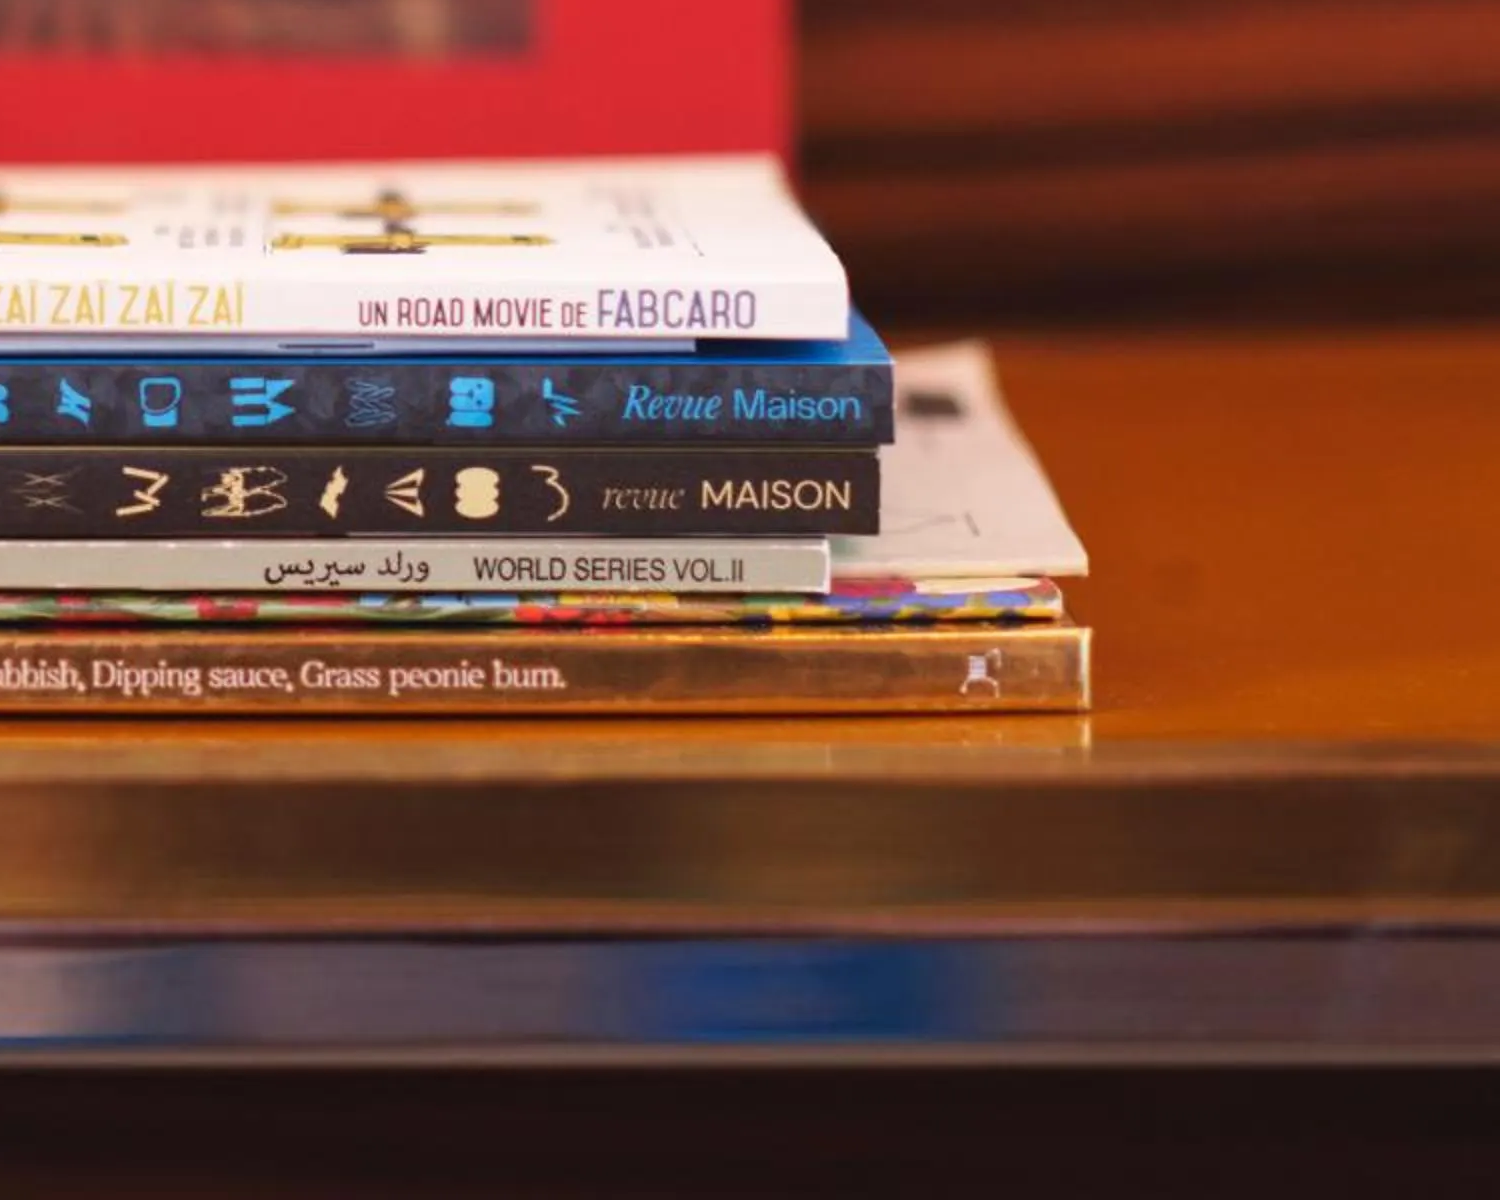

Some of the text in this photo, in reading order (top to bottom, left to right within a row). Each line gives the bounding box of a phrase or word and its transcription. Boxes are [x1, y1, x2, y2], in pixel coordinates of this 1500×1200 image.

[49, 279, 106, 324] ZAÏ
[119, 279, 175, 324] ZAÏ
[188, 279, 244, 326] ZAÏ
[358, 289, 757, 329] UN ROAD MOVIE DE FABCARO
[621, 384, 862, 421] Revue Maison
[602, 479, 852, 511] revue MAISON
[263, 550, 430, 586] ورلد سيريس
[473, 557, 744, 582] WORLD SERIES VOL.II
[93, 659, 203, 695] Dipping
[209, 666, 295, 693] sauce,
[301, 659, 382, 689] Grass
[388, 659, 485, 697] peonie
